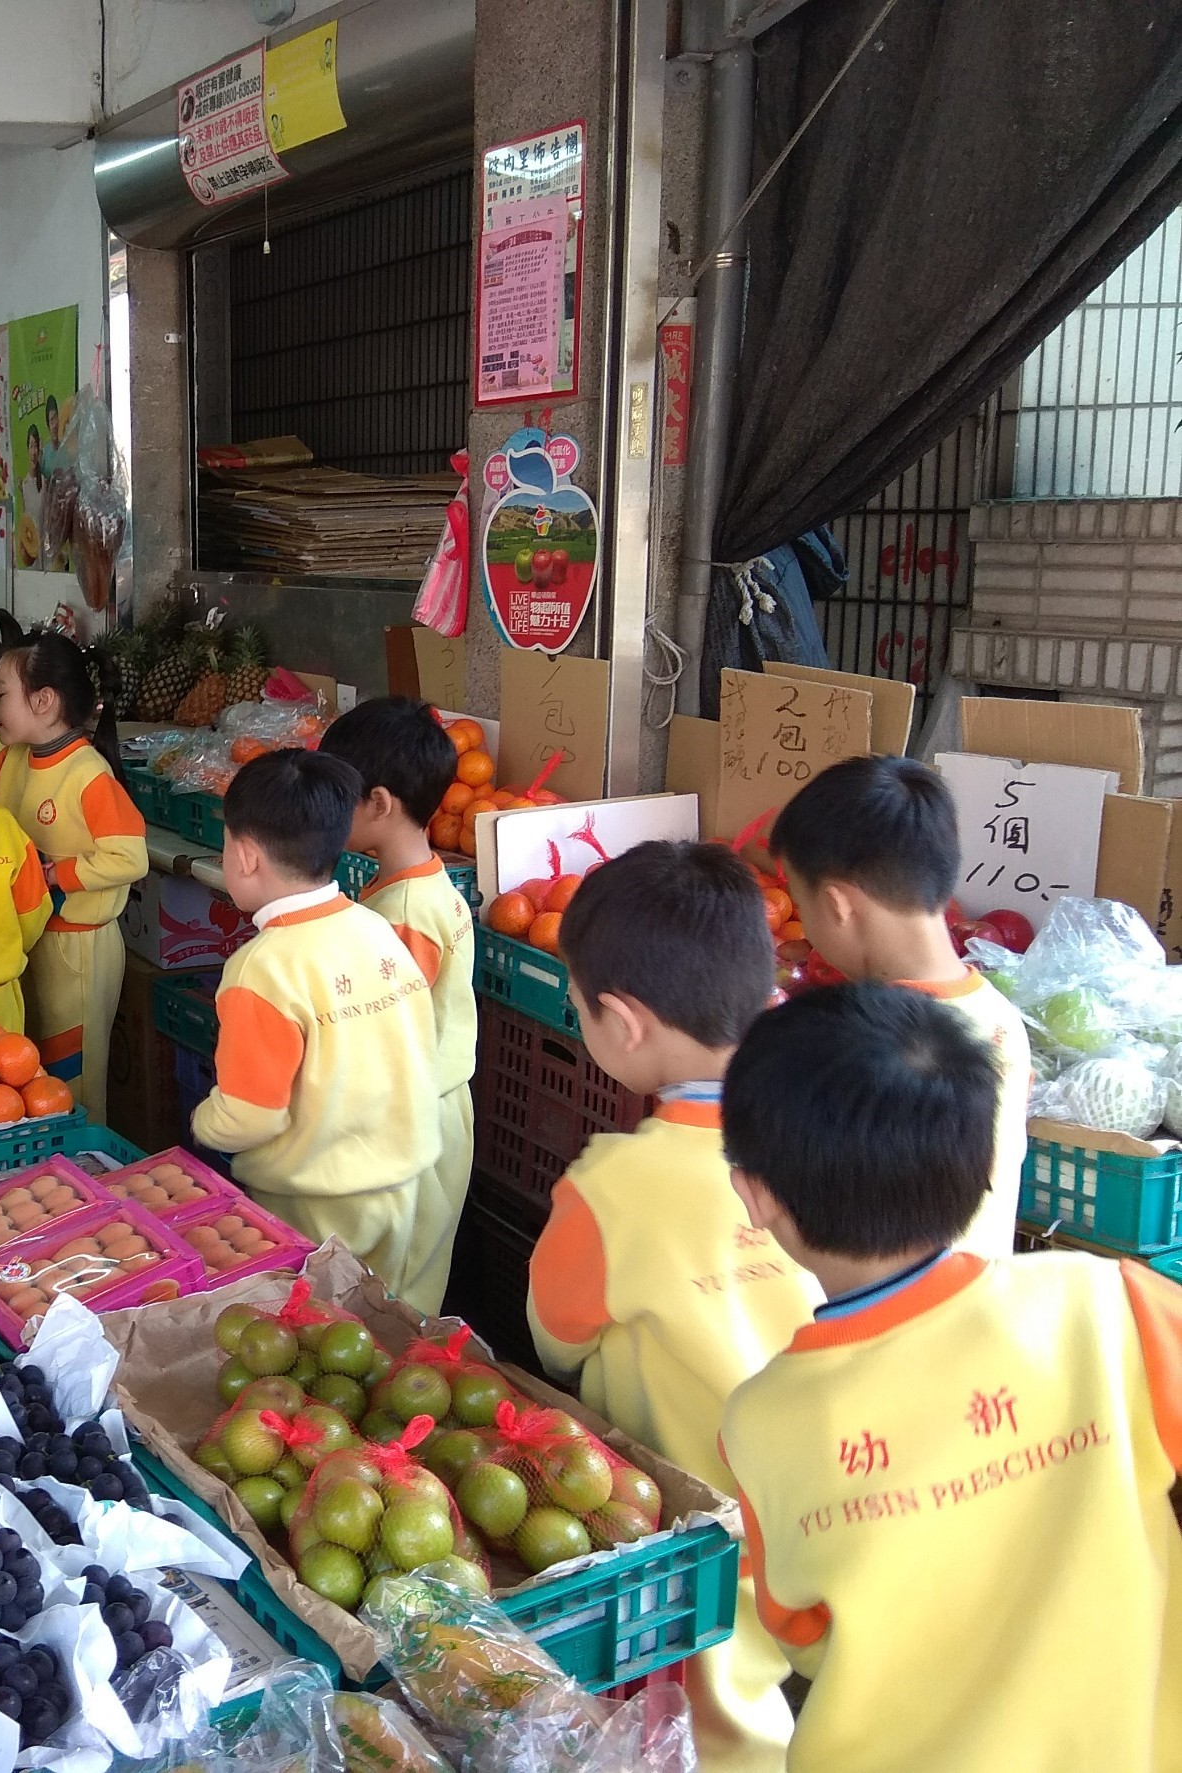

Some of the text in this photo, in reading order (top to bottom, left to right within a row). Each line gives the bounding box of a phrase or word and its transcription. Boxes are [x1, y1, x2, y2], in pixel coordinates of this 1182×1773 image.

[664, 331, 683, 341] FIRE
[510, 594, 528, 605] LIVE
[530, 602, 571, 615] 物超所值
[510, 610, 528, 620] LOVE
[510, 620, 528, 632] LIFE
[529, 615, 571, 628] 魅力十足
[538, 692, 576, 736] 包
[775, 685, 806, 718] 2
[772, 723, 806, 751] 包
[756, 752, 811, 781] 100
[995, 780, 1036, 808] 5
[983, 814, 1029, 854] 個
[335, 958, 396, 995] 幼 新
[316, 1011, 338, 1026] YU
[838, 1385, 1019, 1478] 幼 新
[798, 1419, 1111, 1539] YU HSIN PRESCHOOL
